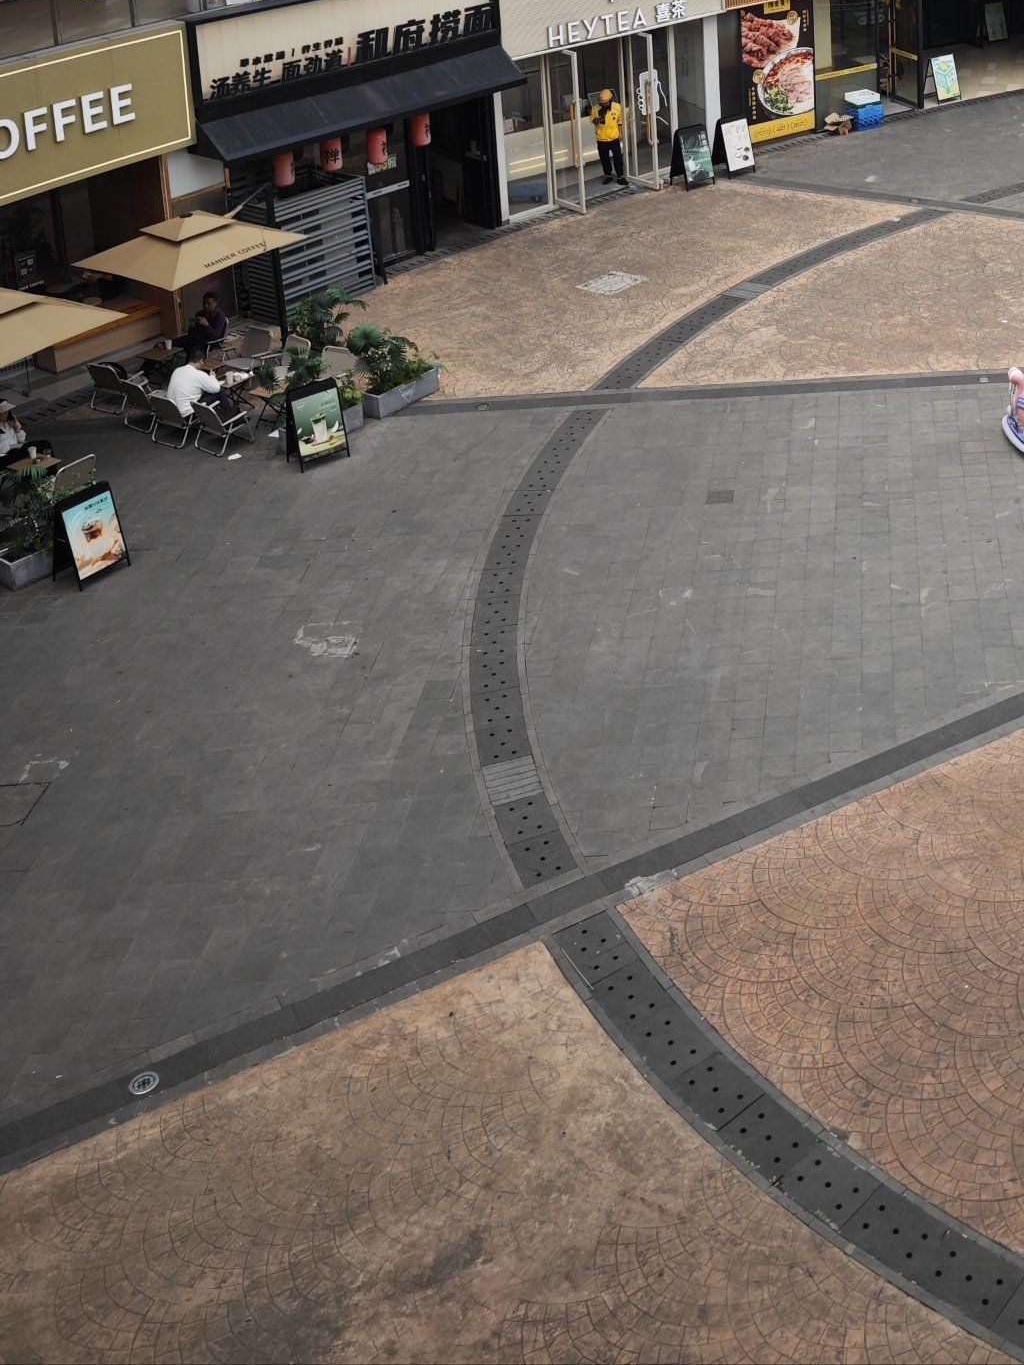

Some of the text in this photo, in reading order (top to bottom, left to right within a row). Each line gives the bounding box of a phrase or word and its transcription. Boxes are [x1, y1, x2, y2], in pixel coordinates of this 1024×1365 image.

[356, 1, 495, 64] 和府捞面
[548, 7, 648, 49] HEYTEA
[204, 252, 237, 269] MANNER
